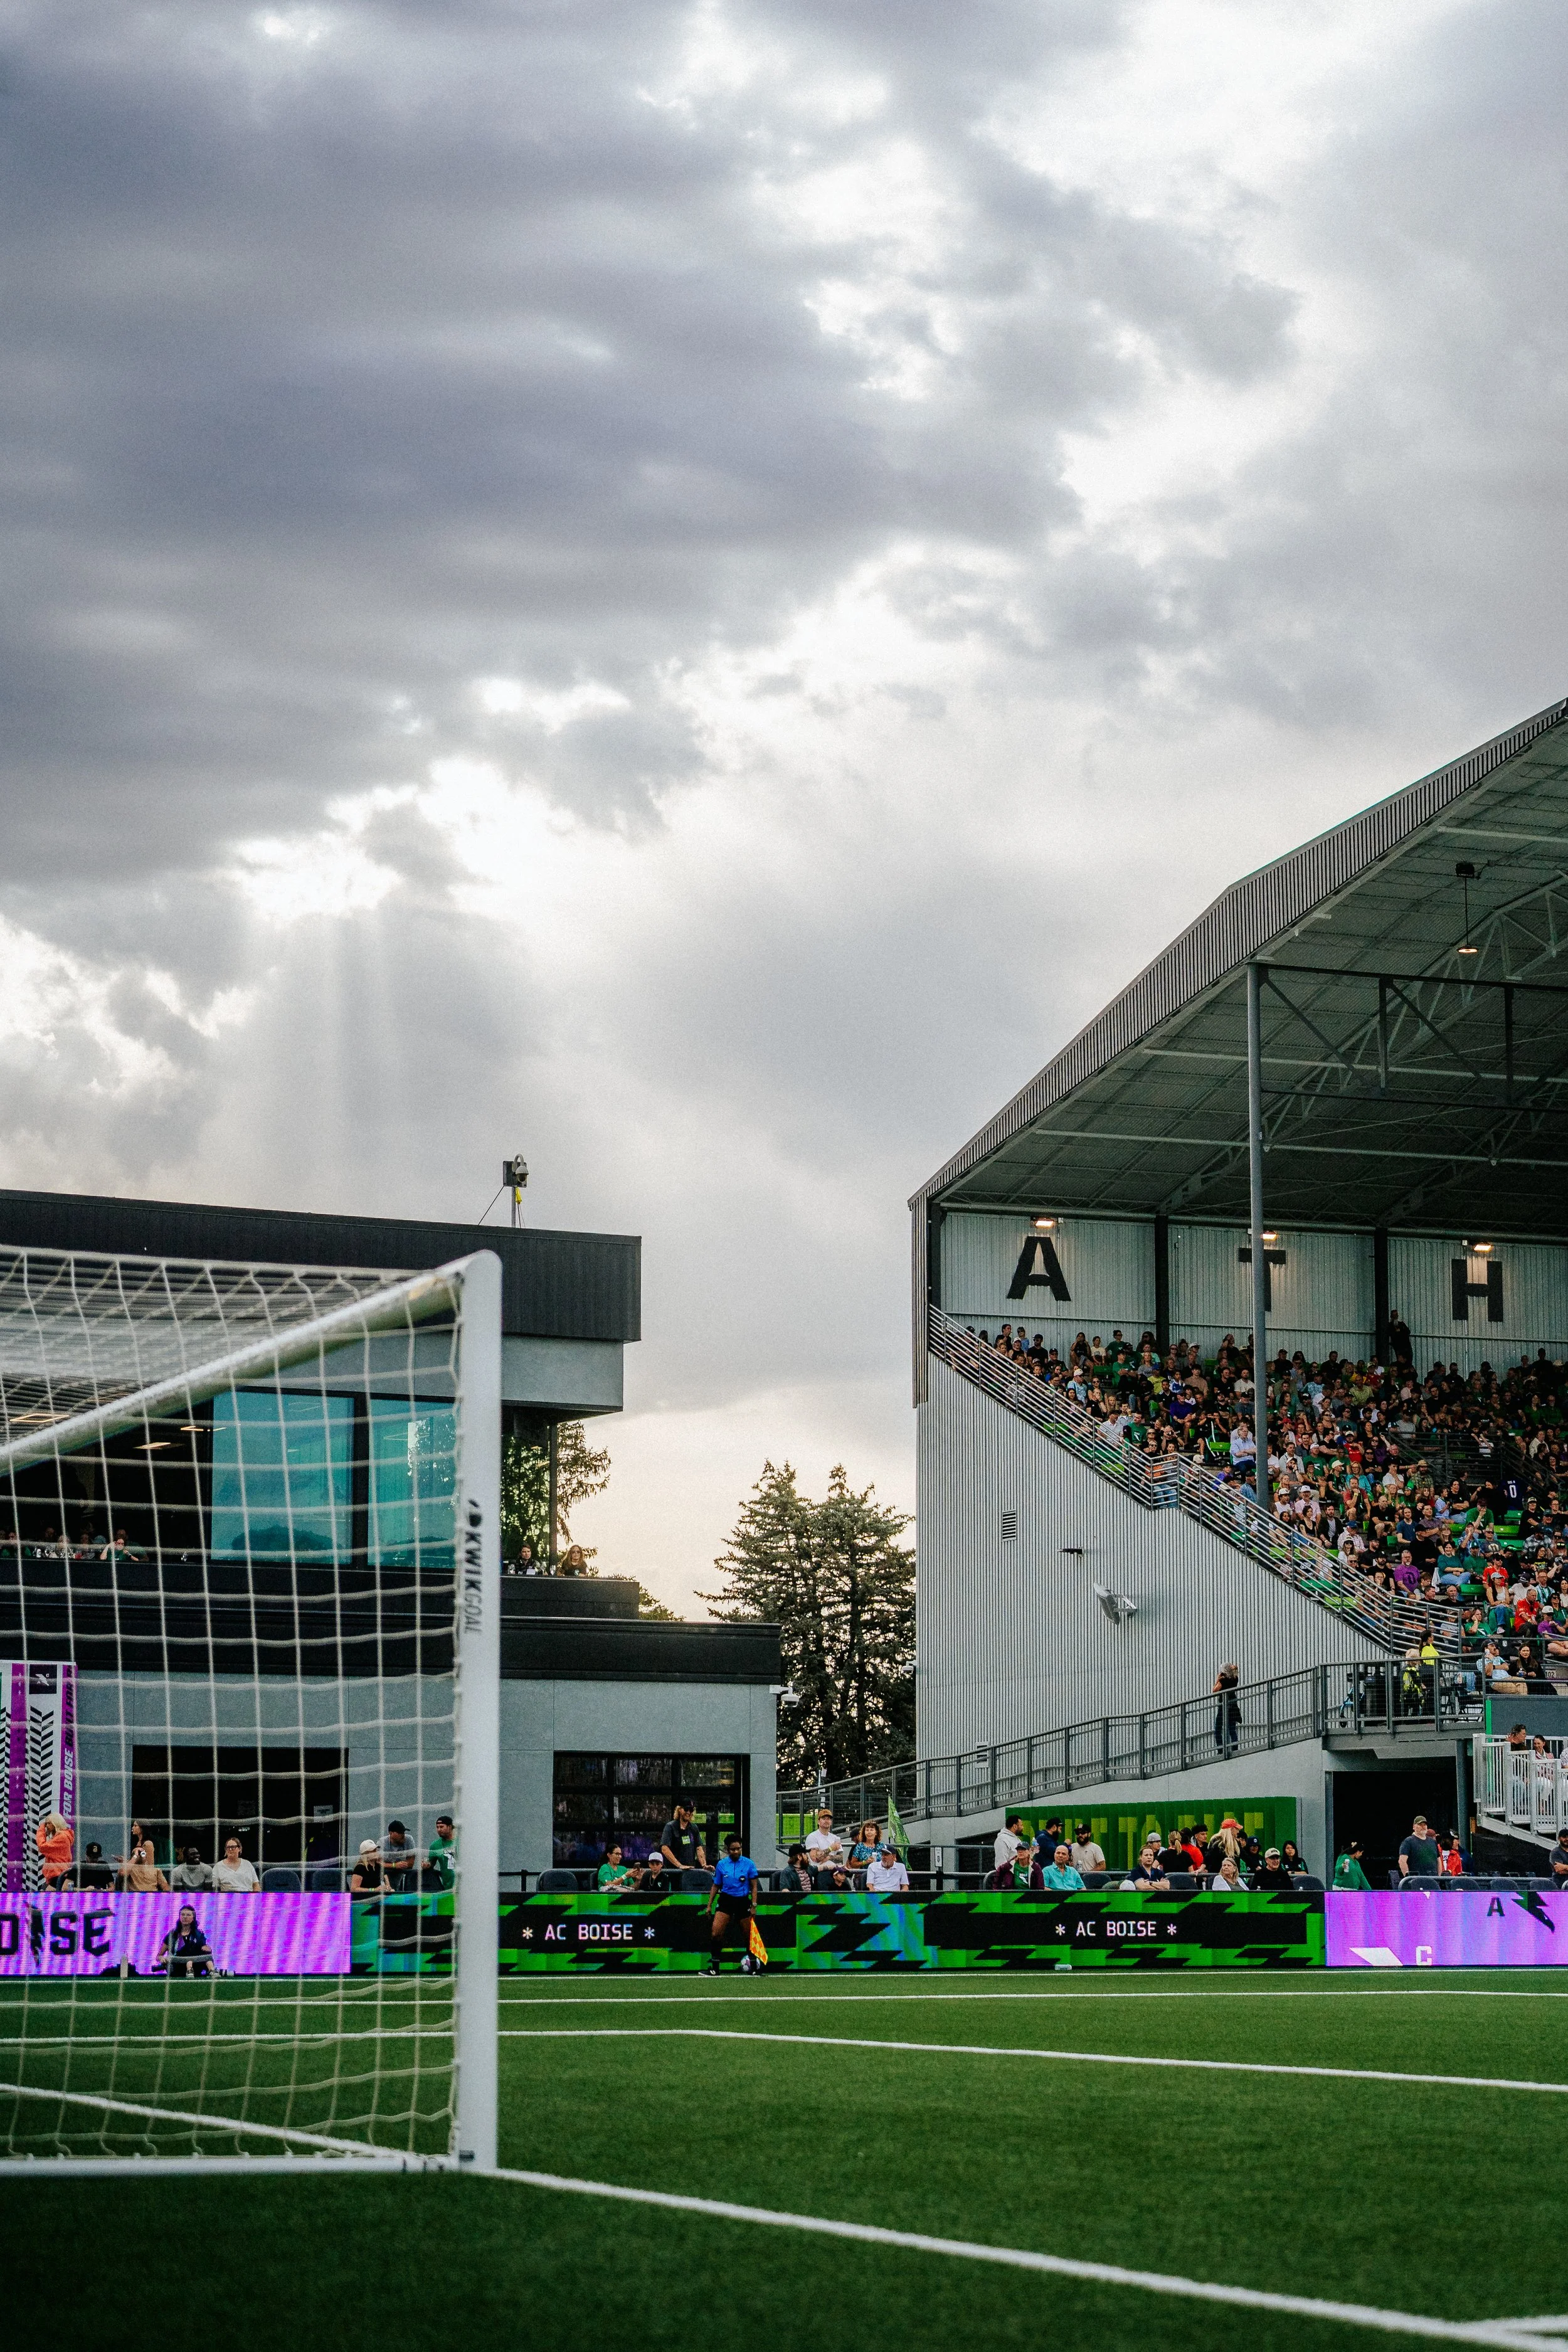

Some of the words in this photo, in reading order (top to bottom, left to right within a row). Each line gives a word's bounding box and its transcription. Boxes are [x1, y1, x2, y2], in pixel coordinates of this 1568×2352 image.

[1006, 1236, 1071, 1301] A
[1451, 1259, 1503, 1322] H
[64, 1747, 73, 1791] BOISE
[63, 1791, 72, 1820] FOR
[1486, 1896, 1505, 1917] A
[544, 1924, 566, 1941] AC
[578, 1924, 633, 1941] BOISE
[1076, 1921, 1096, 1937] AC
[1106, 1920, 1157, 1937] BOISE
[1416, 1945, 1433, 1966] C
